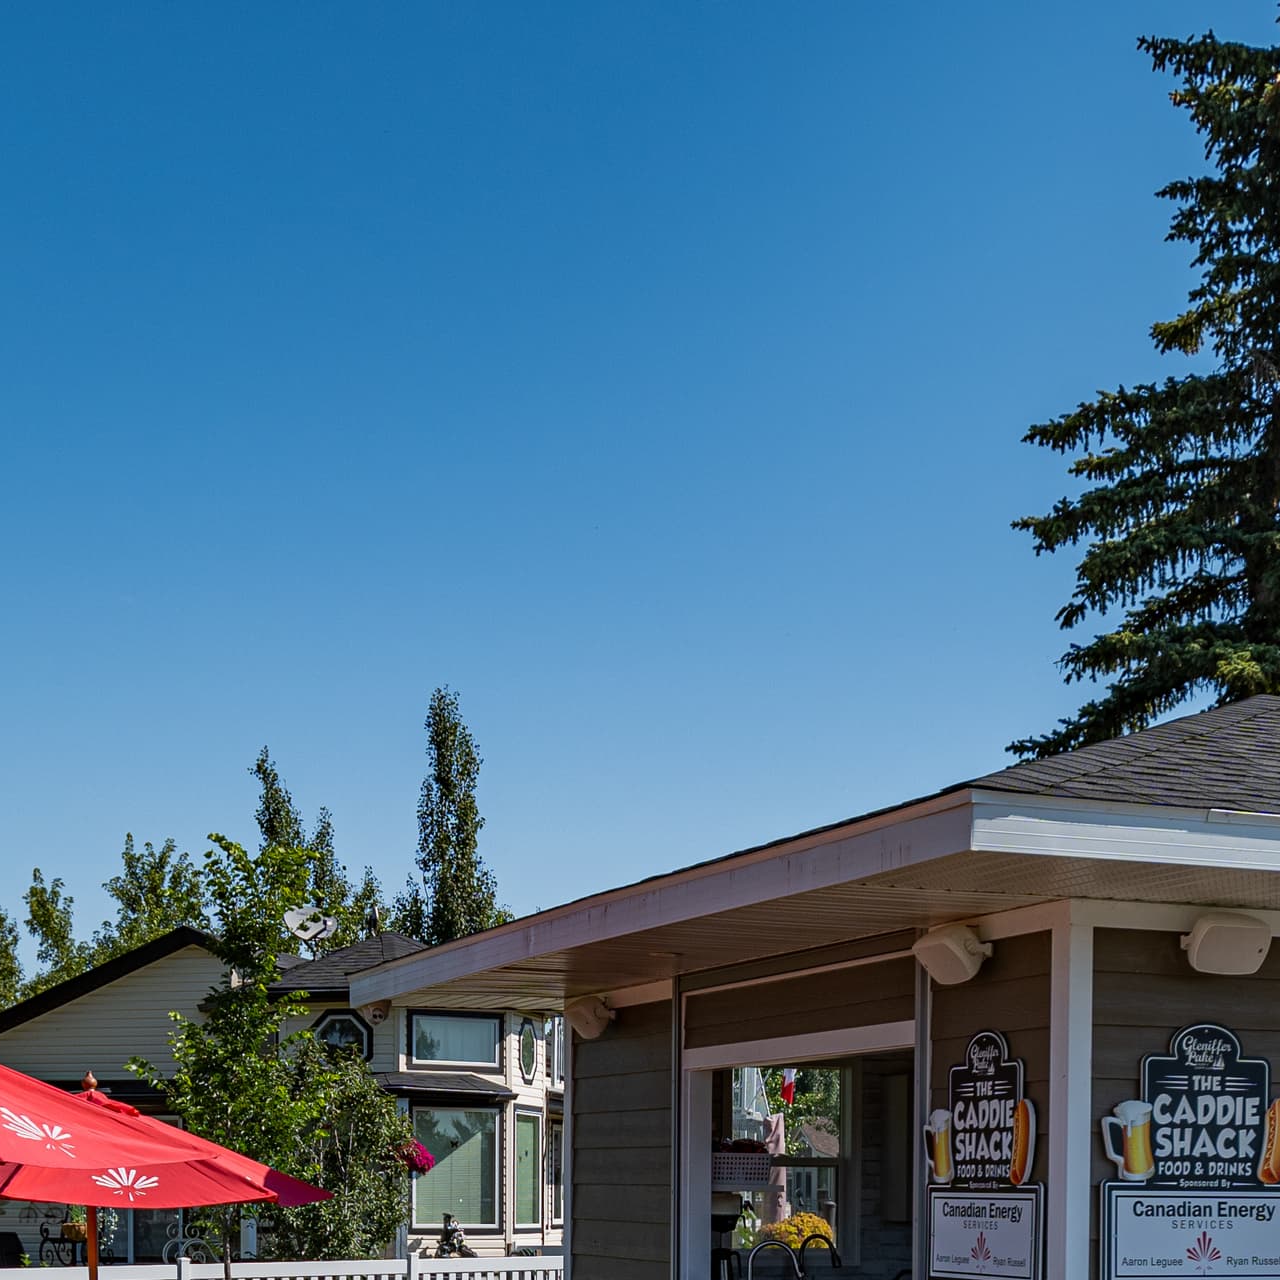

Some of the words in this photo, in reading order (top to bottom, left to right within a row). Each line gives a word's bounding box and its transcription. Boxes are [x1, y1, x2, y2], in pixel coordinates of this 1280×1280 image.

[1182, 1035, 1232, 1055] Gleniffer
[1185, 1052, 1214, 1066] Lake
[976, 1080, 993, 1096] THE
[1192, 1075, 1222, 1091] THE
[953, 1099, 1015, 1130] CADDIE
[1153, 1093, 1260, 1125] CADDIE
[955, 1131, 1012, 1161] SHACK
[1155, 1127, 1257, 1158] SHACK
[957, 1165, 976, 1178] FOOD
[977, 1165, 983, 1177] &
[985, 1164, 1010, 1178] DRINKS
[1158, 1161, 1191, 1176] FOOD
[1194, 1161, 1205, 1176] &
[1208, 1162, 1252, 1176] DRINKS
[1179, 1178, 1219, 1188] Sponsored
[1221, 1179, 1231, 1188] By
[942, 1201, 987, 1218] Canadian
[989, 1203, 1023, 1223] Energy
[1133, 1200, 1212, 1218] Canadian
[1217, 1201, 1276, 1221] Energy
[963, 1220, 999, 1230] SERVICES
[1171, 1220, 1234, 1230] SERVICES
[1121, 1256, 1148, 1266] Aaron
[1151, 1257, 1183, 1268] Leguee
[1226, 1256, 1249, 1268] Ryan
